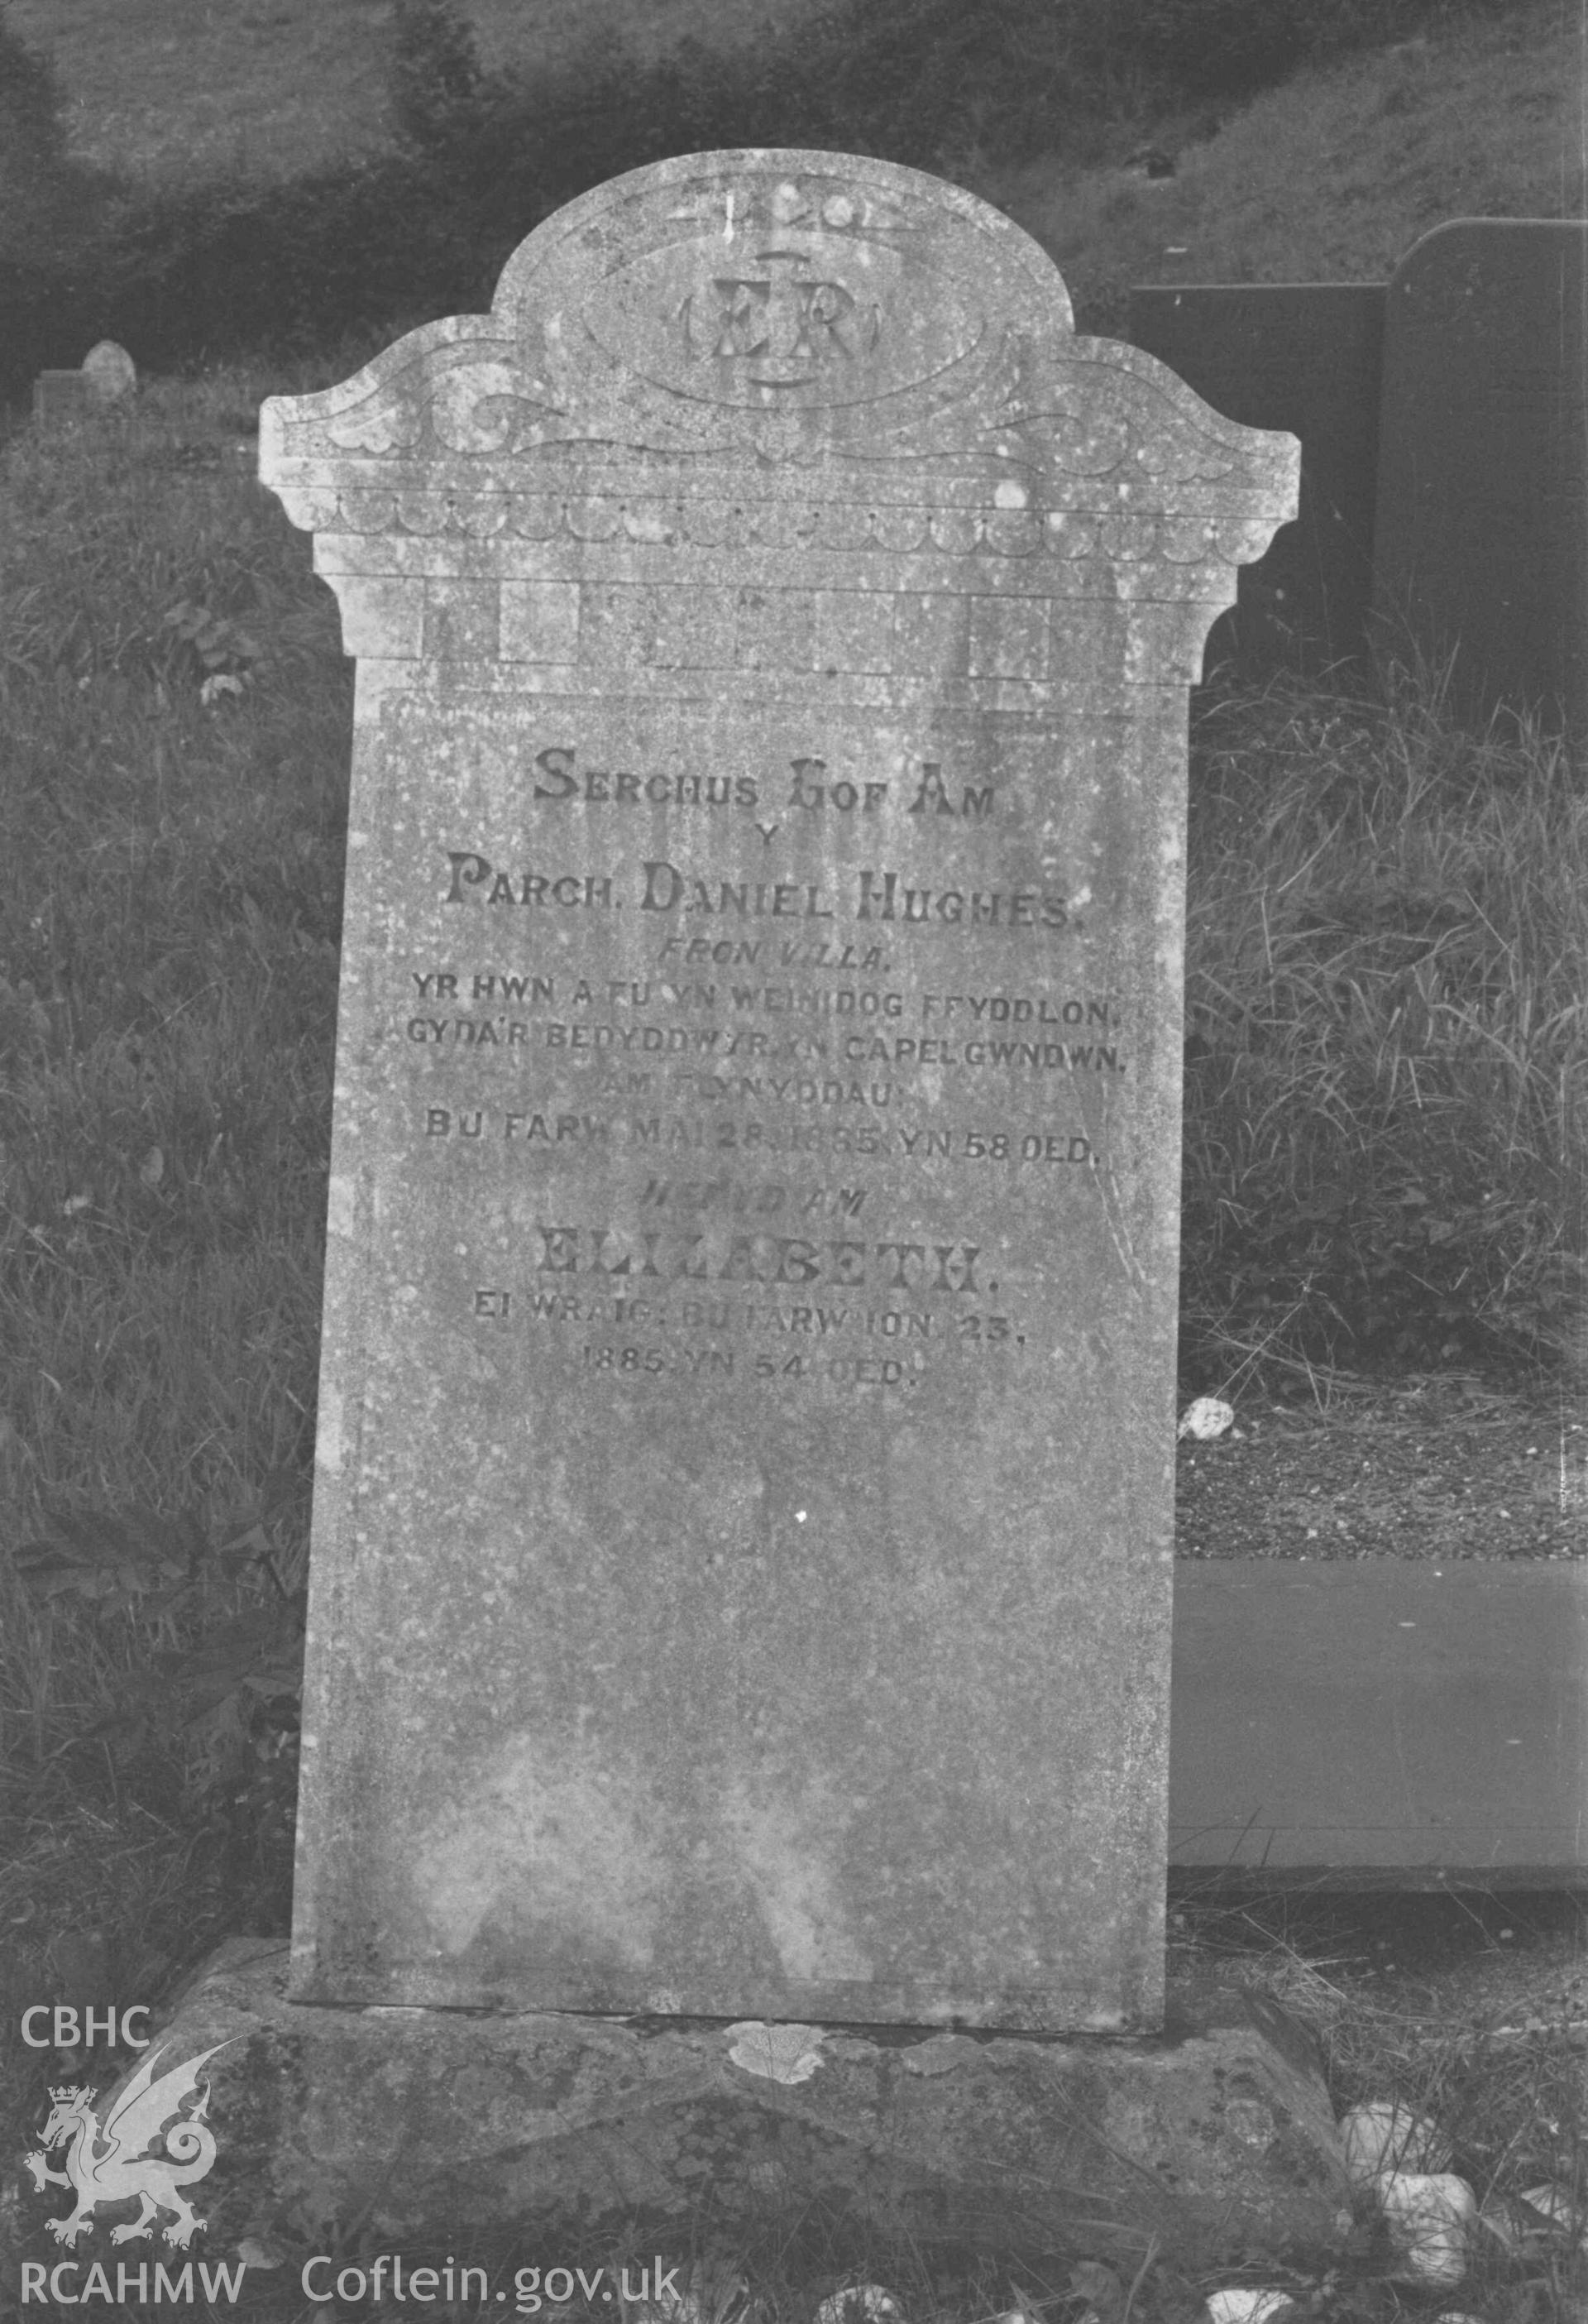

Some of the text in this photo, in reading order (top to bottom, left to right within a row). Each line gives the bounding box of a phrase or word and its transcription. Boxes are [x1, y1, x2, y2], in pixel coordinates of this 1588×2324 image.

[533, 747, 992, 816] SERCHUS GOF AM
[755, 823, 778, 846] Y
[447, 851, 1083, 929] PARCH. DANIEL HUGHES.
[414, 972, 459, 999] YR
[472, 975, 553, 1001] HWN
[572, 980, 592, 1004] A
[607, 982, 651, 1006] FU
[406, 1017, 529, 1046] GYDA'R
[427, 1110, 482, 1138] BU
[899, 1130, 951, 1157] YN
[964, 1133, 1009, 1159] 58
[475, 1289, 509, 1317] EI
[753, 1354, 806, 1381] 54
